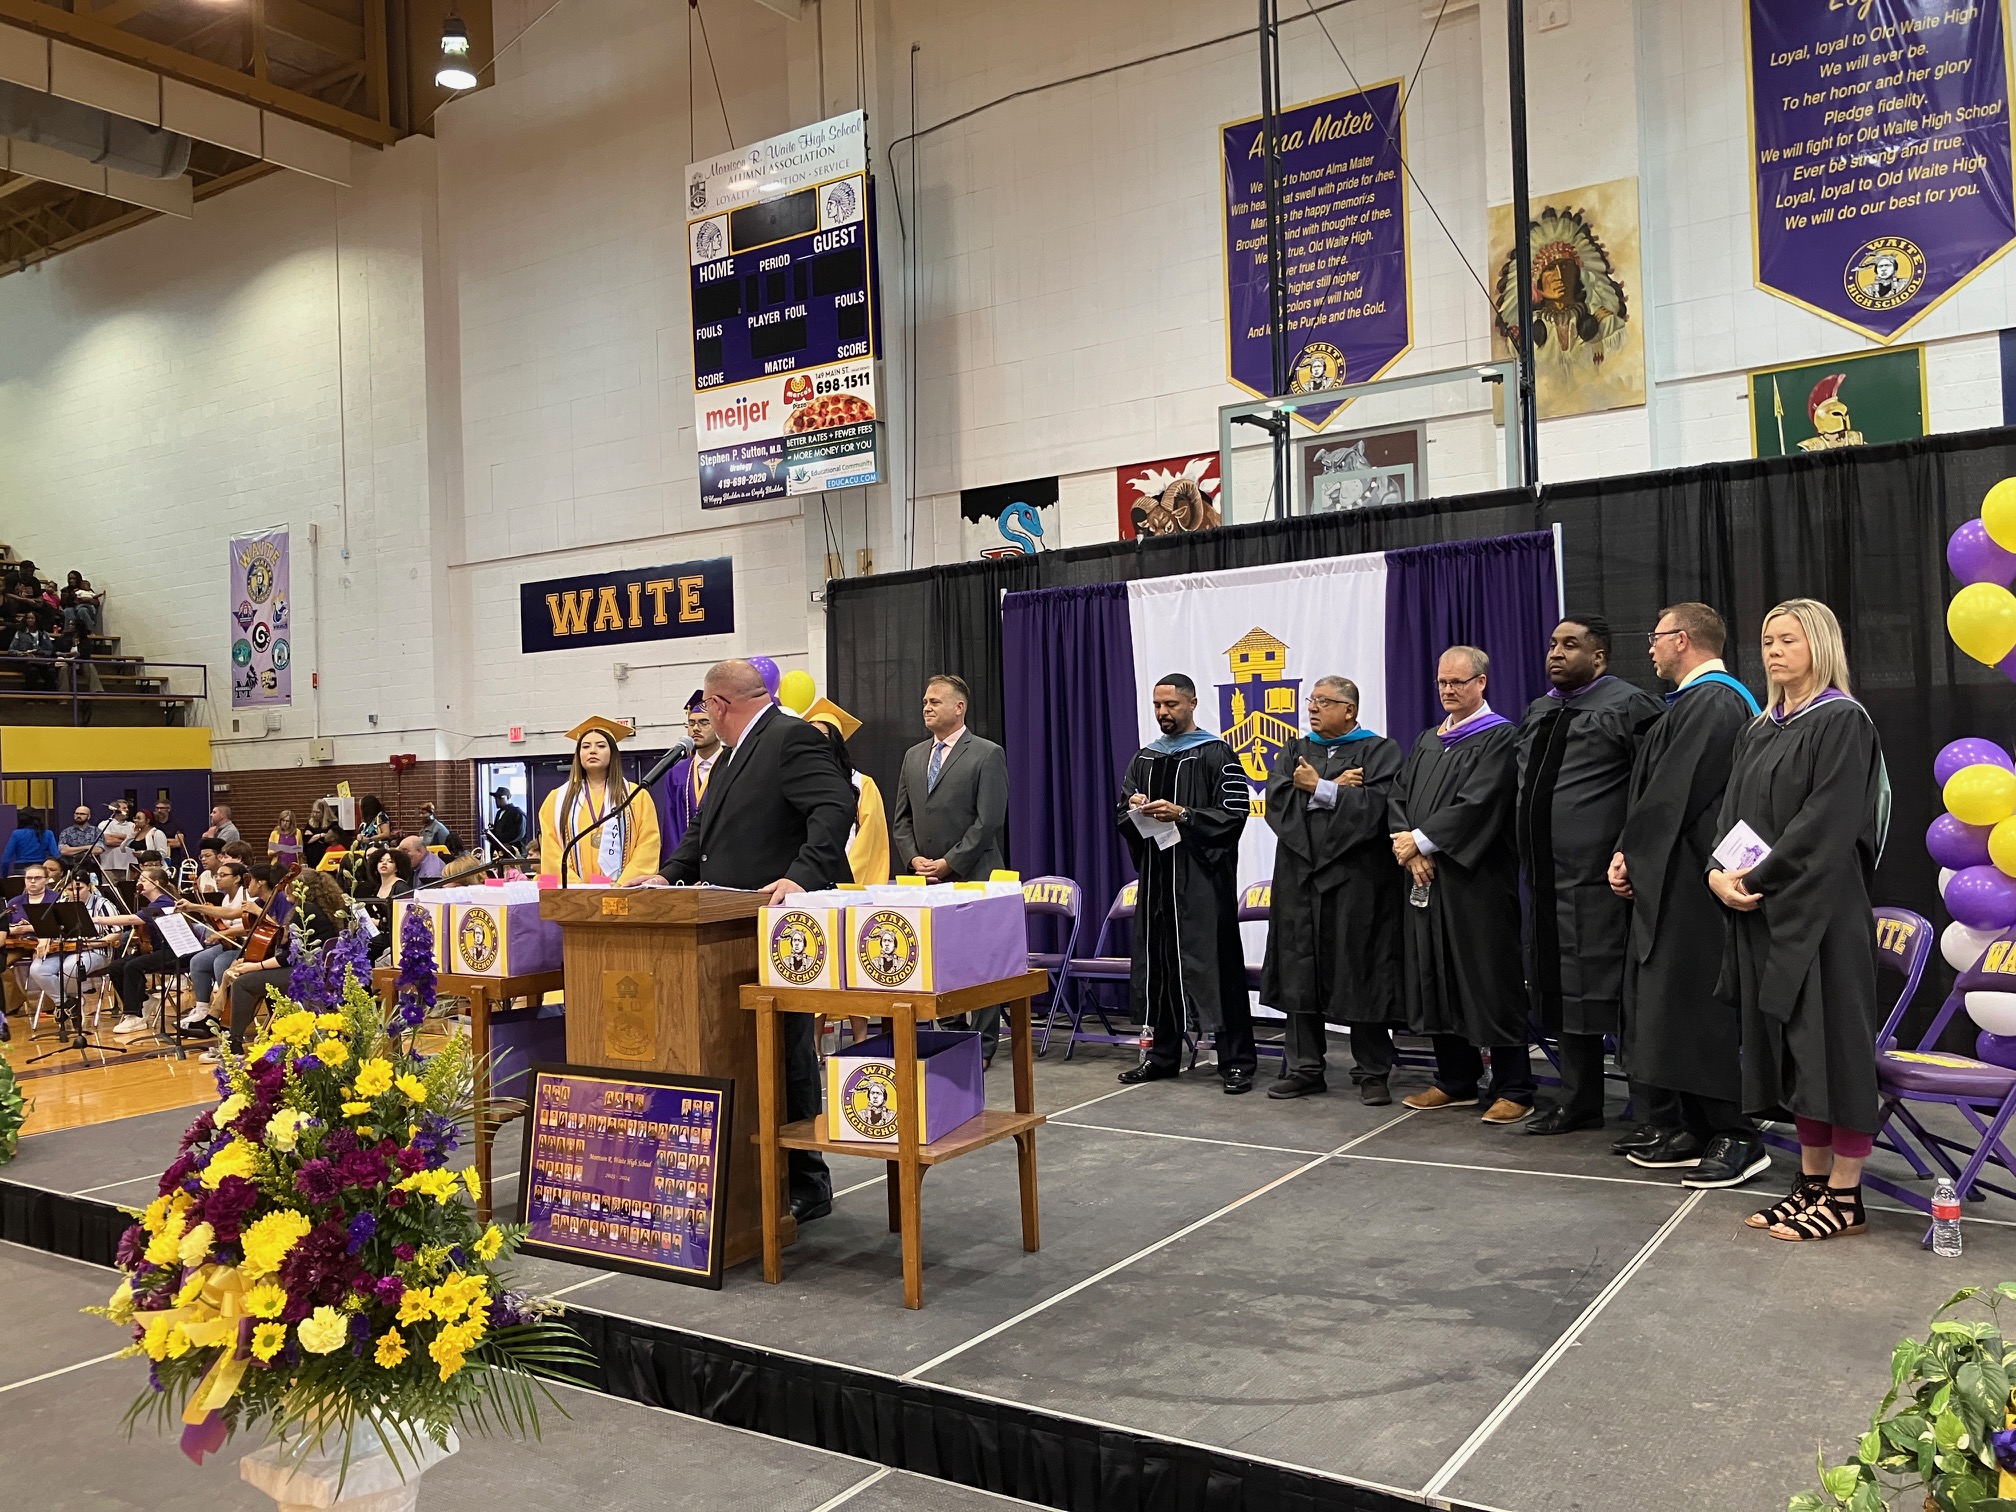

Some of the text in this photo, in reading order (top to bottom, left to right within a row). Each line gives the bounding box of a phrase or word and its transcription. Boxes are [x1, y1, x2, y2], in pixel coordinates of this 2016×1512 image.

[1770, 7, 1977, 67] Loyal, loyal to Old Waite High
[1820, 43, 1929, 78] We will ever be.
[1783, 58, 1971, 111] To her honor and her glory
[1825, 93, 1928, 126] Pledge fidelity.
[1308, 110, 1374, 145] Mater
[1761, 99, 2001, 164] We will fight for Old Waite High School
[705, 118, 861, 180] Morrison R. Waite High School
[1793, 135, 1965, 181] Ever be strong and true.
[728, 145, 835, 184] ALUMNI ASSOCIATION
[1250, 182, 1263, 194] We
[1290, 174, 1297, 185] to
[1300, 167, 1324, 182] honor
[1326, 162, 1348, 178] Alma
[1349, 155, 1374, 173] Mater
[716, 159, 850, 206] LOYALTY SERVICE
[1776, 154, 1987, 208] Loyal, loyal to Old Waite High
[1231, 203, 1249, 217] With
[1295, 187, 1316, 201] swell
[1318, 182, 1335, 195] with
[1337, 178, 1358, 194] pride
[1361, 174, 1373, 186] for
[1290, 192, 1375, 221] the happy memories
[1786, 182, 1980, 230] We will do our best for you.
[813, 226, 857, 253] GUEST
[1236, 234, 1267, 252] Brought
[1302, 223, 1319, 236] with
[1322, 213, 1358, 231] thoughts
[1361, 212, 1370, 223] of
[1372, 208, 1392, 220] thee.
[1288, 245, 1306, 257] true,
[1309, 240, 1323, 253] Old
[1326, 235, 1349, 250] Waite
[1351, 230, 1373, 246] High.
[759, 254, 791, 272] PERIOD
[1299, 260, 1315, 273] true
[1318, 258, 1325, 269] to
[1328, 255, 1348, 268] thee.
[1867, 239, 1922, 265] WAITE
[699, 258, 735, 283] HOME
[1288, 280, 1315, 295] higher
[1316, 275, 1330, 289] still
[1848, 278, 1921, 308] HIGH SCHOOL
[835, 291, 864, 308] FOULS
[1286, 299, 1311, 314] colors
[1328, 291, 1341, 304] will
[1343, 287, 1362, 300] hold
[748, 304, 808, 329] PLAYER FOUL
[1248, 325, 1264, 339] And
[1329, 309, 1345, 322] and
[1347, 306, 1360, 318] the
[1363, 301, 1386, 316] Gold.
[696, 324, 723, 340] FOULS
[837, 341, 868, 359] SCORE
[1304, 344, 1343, 366] WAITE
[765, 357, 795, 374] MATCH
[825, 369, 840, 377] MAIN
[842, 366, 850, 375] ST.
[698, 372, 724, 388] SCORE
[787, 387, 812, 398] marco's
[816, 372, 870, 394] 698-1511
[706, 397, 770, 431] meijer
[787, 435, 806, 447] BETTER
[808, 432, 827, 443] RATES
[835, 428, 856, 439] FEWER
[858, 425, 873, 434] FEES
[700, 445, 782, 467] Stephen P. Sutton, M.D.
[794, 440, 872, 461] MORE MONEY FOR YOU
[718, 473, 767, 489] 419-698-2020
[730, 463, 753, 472] Urology
[811, 465, 841, 476] Educational
[842, 460, 872, 471] Community
[828, 474, 876, 488] EDUCACU.COM
[240, 541, 280, 570] WAITE
[546, 575, 705, 637] WAITE
[1022, 883, 1073, 906] WAITE
[785, 914, 824, 947] WAITE
[875, 913, 916, 947] WAITE
[474, 950, 496, 970] SCHOOL
[772, 951, 823, 983] HIGH SCHOOL
[860, 952, 915, 984] HIGH SCHOOL
[845, 1104, 865, 1132] HIGH
